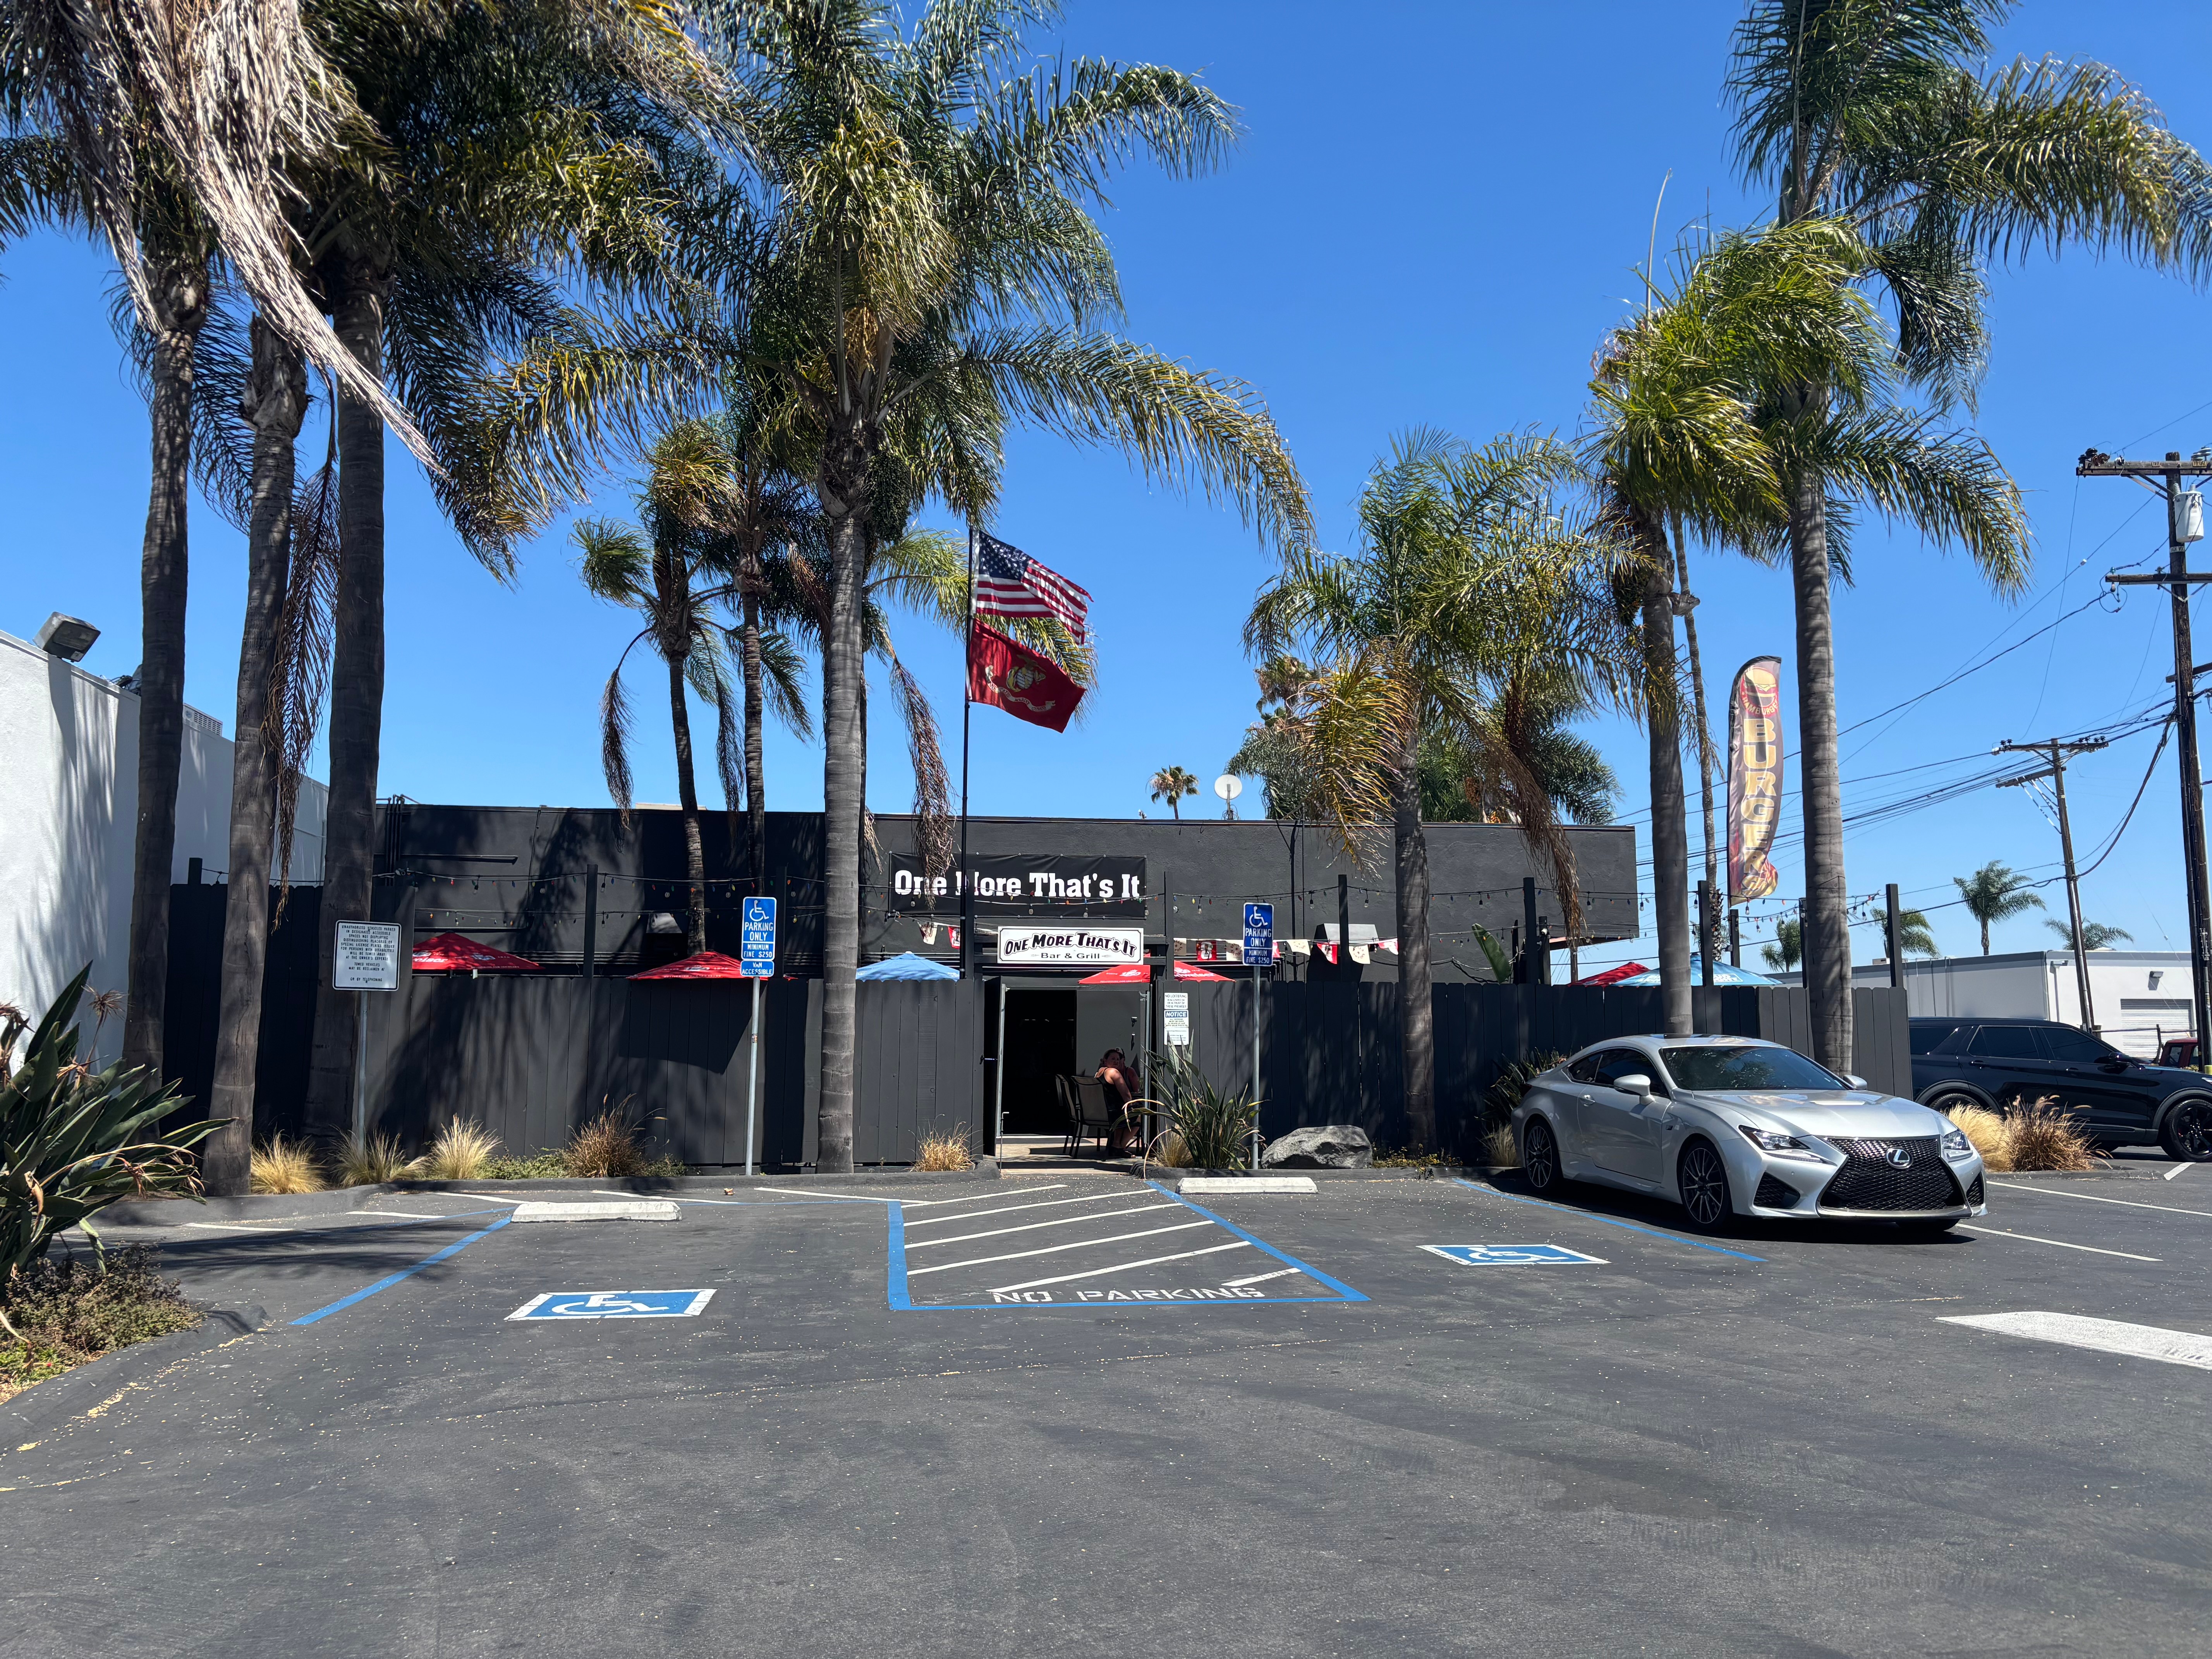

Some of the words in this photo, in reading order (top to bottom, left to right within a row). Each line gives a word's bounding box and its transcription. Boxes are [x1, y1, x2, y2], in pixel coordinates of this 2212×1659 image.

[895, 870, 947, 895] One
[1029, 872, 1114, 898] That's
[1121, 874, 1140, 898] It
[745, 922, 773, 931] PARKING
[750, 932, 767, 941] ONLY
[1245, 928, 1271, 937] PARKING
[1005, 939, 1029, 956] ONE
[1033, 933, 1072, 948] MORE
[1076, 932, 1121, 951] THAT'S
[1122, 940, 1137, 957] IT
[1250, 938, 1266, 947] ONLY
[994, 1291, 1053, 1303] NO
[1077, 1287, 1265, 1301] PARKING
